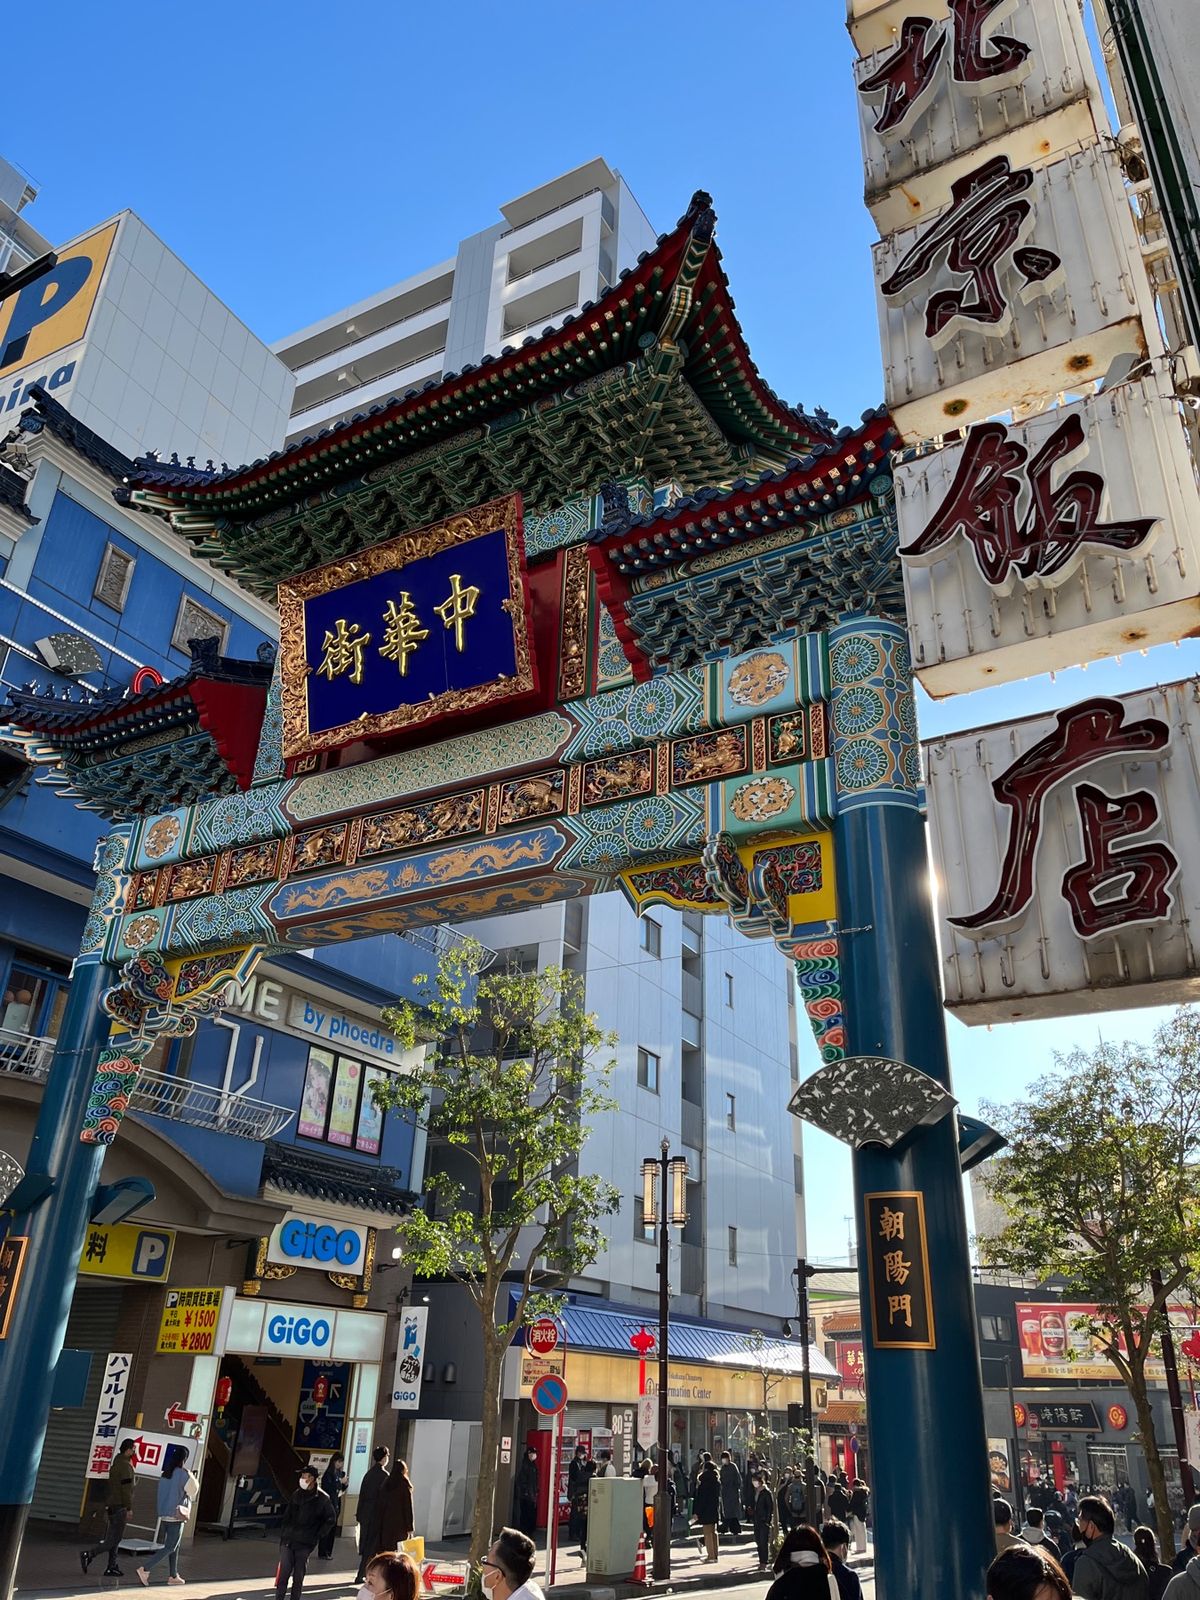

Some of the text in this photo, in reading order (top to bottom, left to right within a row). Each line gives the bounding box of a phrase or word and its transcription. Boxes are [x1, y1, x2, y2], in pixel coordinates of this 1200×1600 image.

[0, 360, 77, 413] ina
[317, 574, 480, 684] 中華街
[303, 1001, 395, 1054] by phoedra
[136, 1236, 165, 1272] P
[280, 1219, 361, 1265] GiGO
[879, 1207, 913, 1327] 朝陽門
[178, 1290, 221, 1307] 時間貸駐車場
[268, 1315, 330, 1347] GiGO
[532, 1329, 556, 1343] 消火栓
[393, 1391, 416, 1401] GiGO
[693, 1386, 711, 1399] Center
[90, 1356, 129, 1474] ハイルーフ車 満車
[612, 1414, 622, 1435] 80
